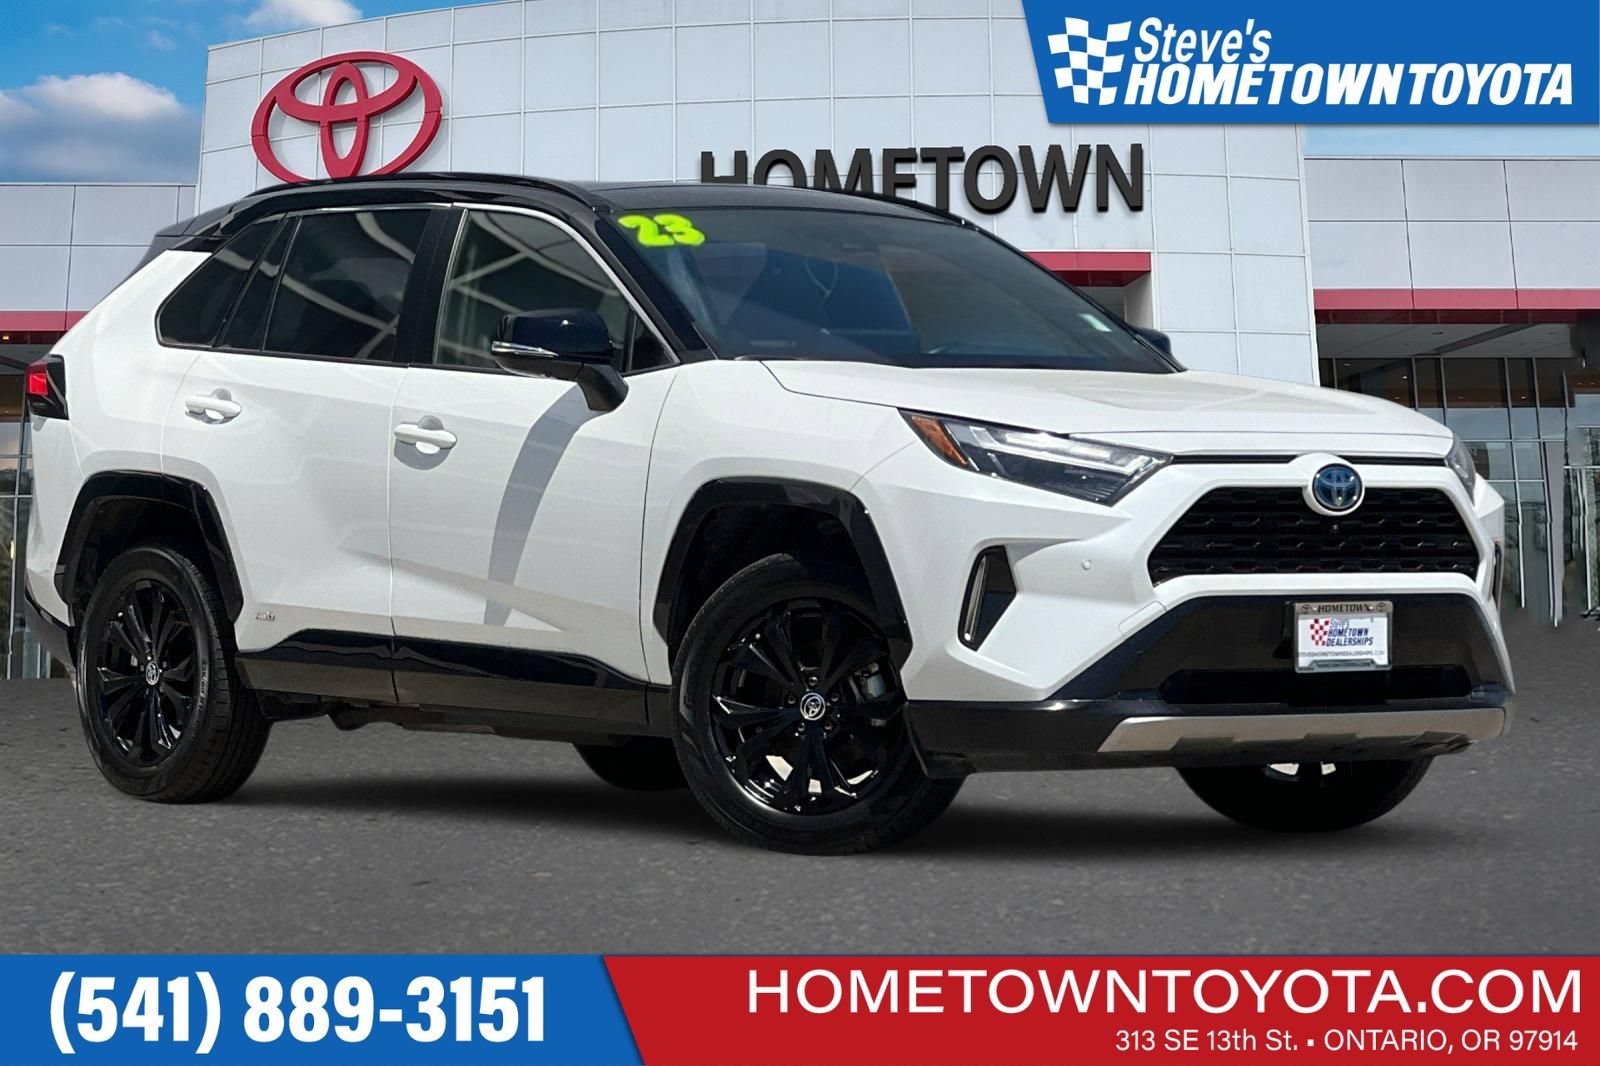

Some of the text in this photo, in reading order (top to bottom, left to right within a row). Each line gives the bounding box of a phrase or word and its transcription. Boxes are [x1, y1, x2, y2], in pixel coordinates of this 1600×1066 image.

[618, 214, 705, 247] 23
[1317, 604, 1372, 613] HOMETOWN
[1327, 628, 1368, 637] HOMETOWN
[1326, 637, 1373, 647] DEALERSHIPS
